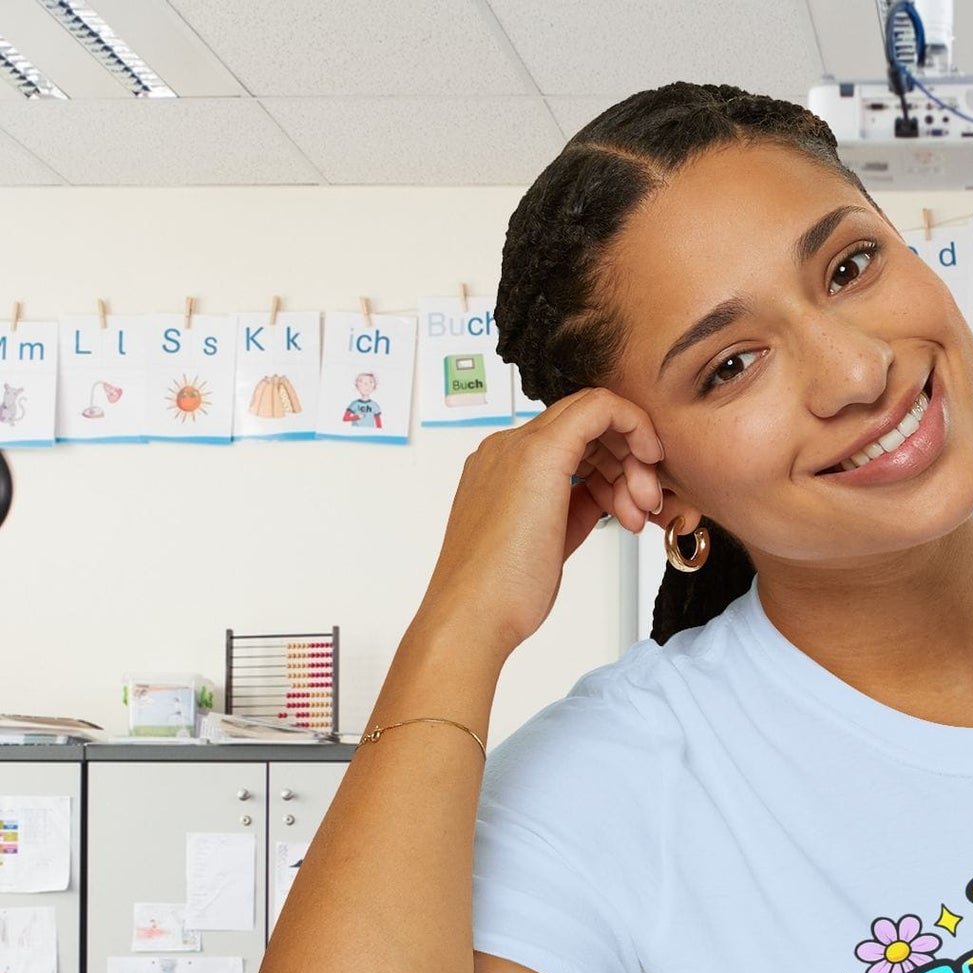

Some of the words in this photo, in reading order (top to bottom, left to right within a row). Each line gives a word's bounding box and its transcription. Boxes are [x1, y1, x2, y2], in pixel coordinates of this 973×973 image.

[938, 241, 957, 267] d
[19, 341, 45, 361] m
[75, 330, 92, 355] L
[162, 328, 182, 354] S
[203, 337, 219, 356] s
[245, 326, 265, 351] K
[285, 326, 302, 351] k
[349, 328, 391, 355] ich
[452, 379, 484, 391] Buch
